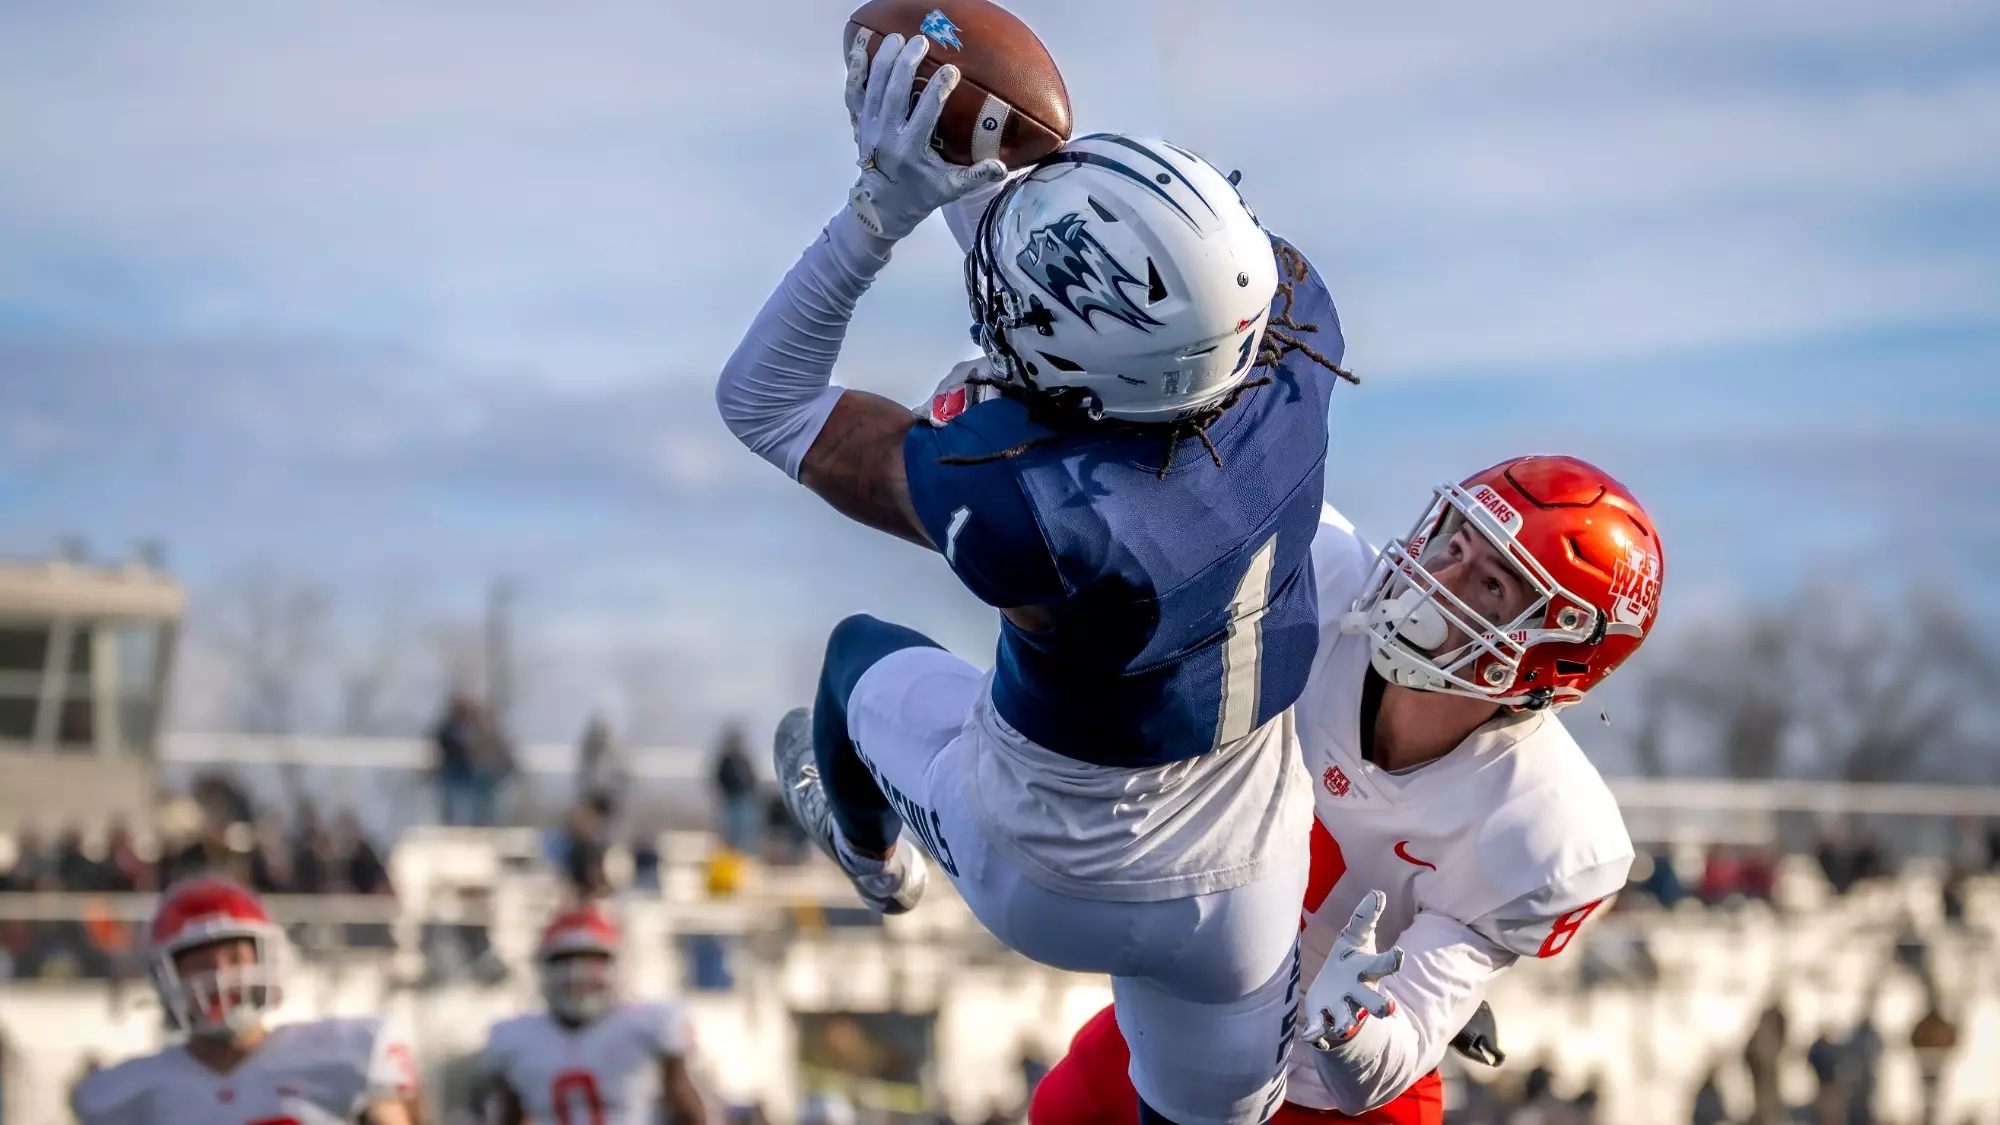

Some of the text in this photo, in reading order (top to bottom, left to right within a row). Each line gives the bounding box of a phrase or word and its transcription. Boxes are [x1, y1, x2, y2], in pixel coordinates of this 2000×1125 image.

[946, 505, 972, 566] 1
[1475, 488, 1515, 524] BEARS
[1608, 557, 1660, 618] WASH
[1212, 533, 1278, 752] 1
[1537, 898, 1604, 959] 8
